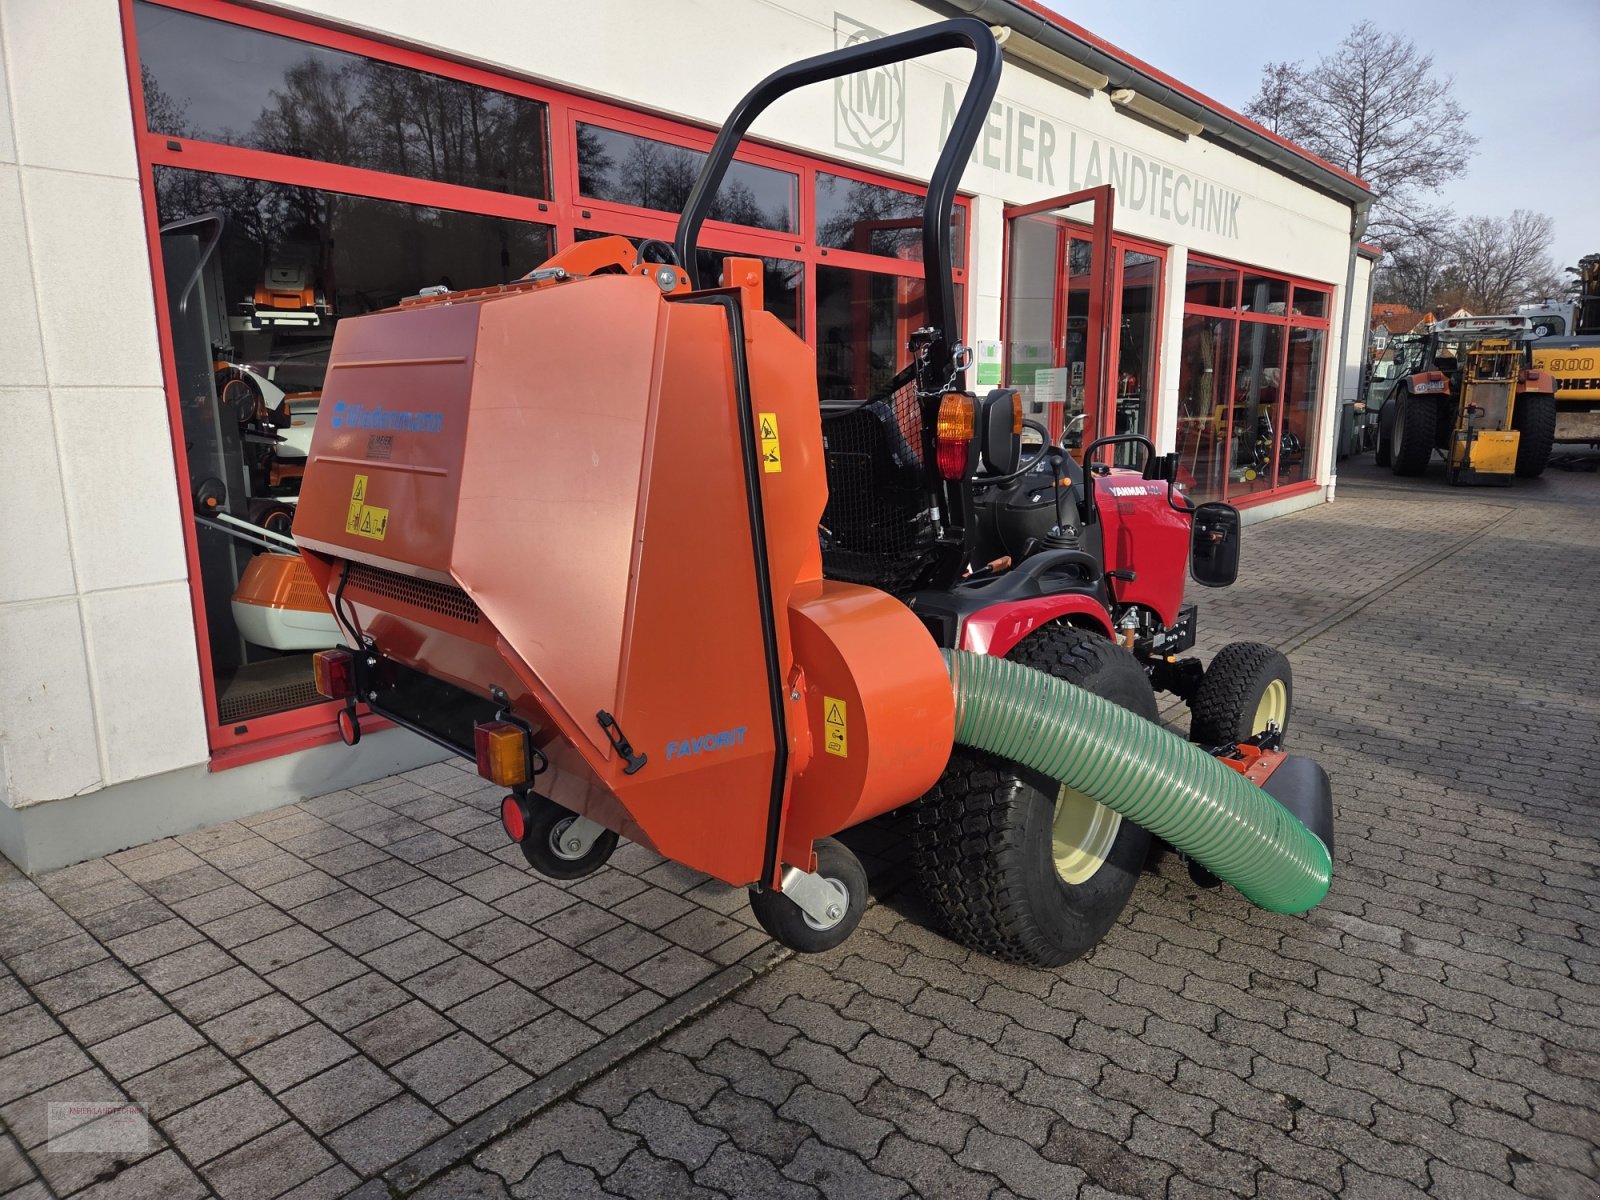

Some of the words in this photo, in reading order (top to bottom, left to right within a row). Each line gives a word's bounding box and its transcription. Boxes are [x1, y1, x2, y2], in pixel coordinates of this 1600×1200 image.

[1069, 131, 1241, 240] LANDTECHNIK
[1550, 357, 1595, 371] 900
[1109, 486, 1148, 497] YANMAR
[665, 726, 748, 761] FAVORIT
